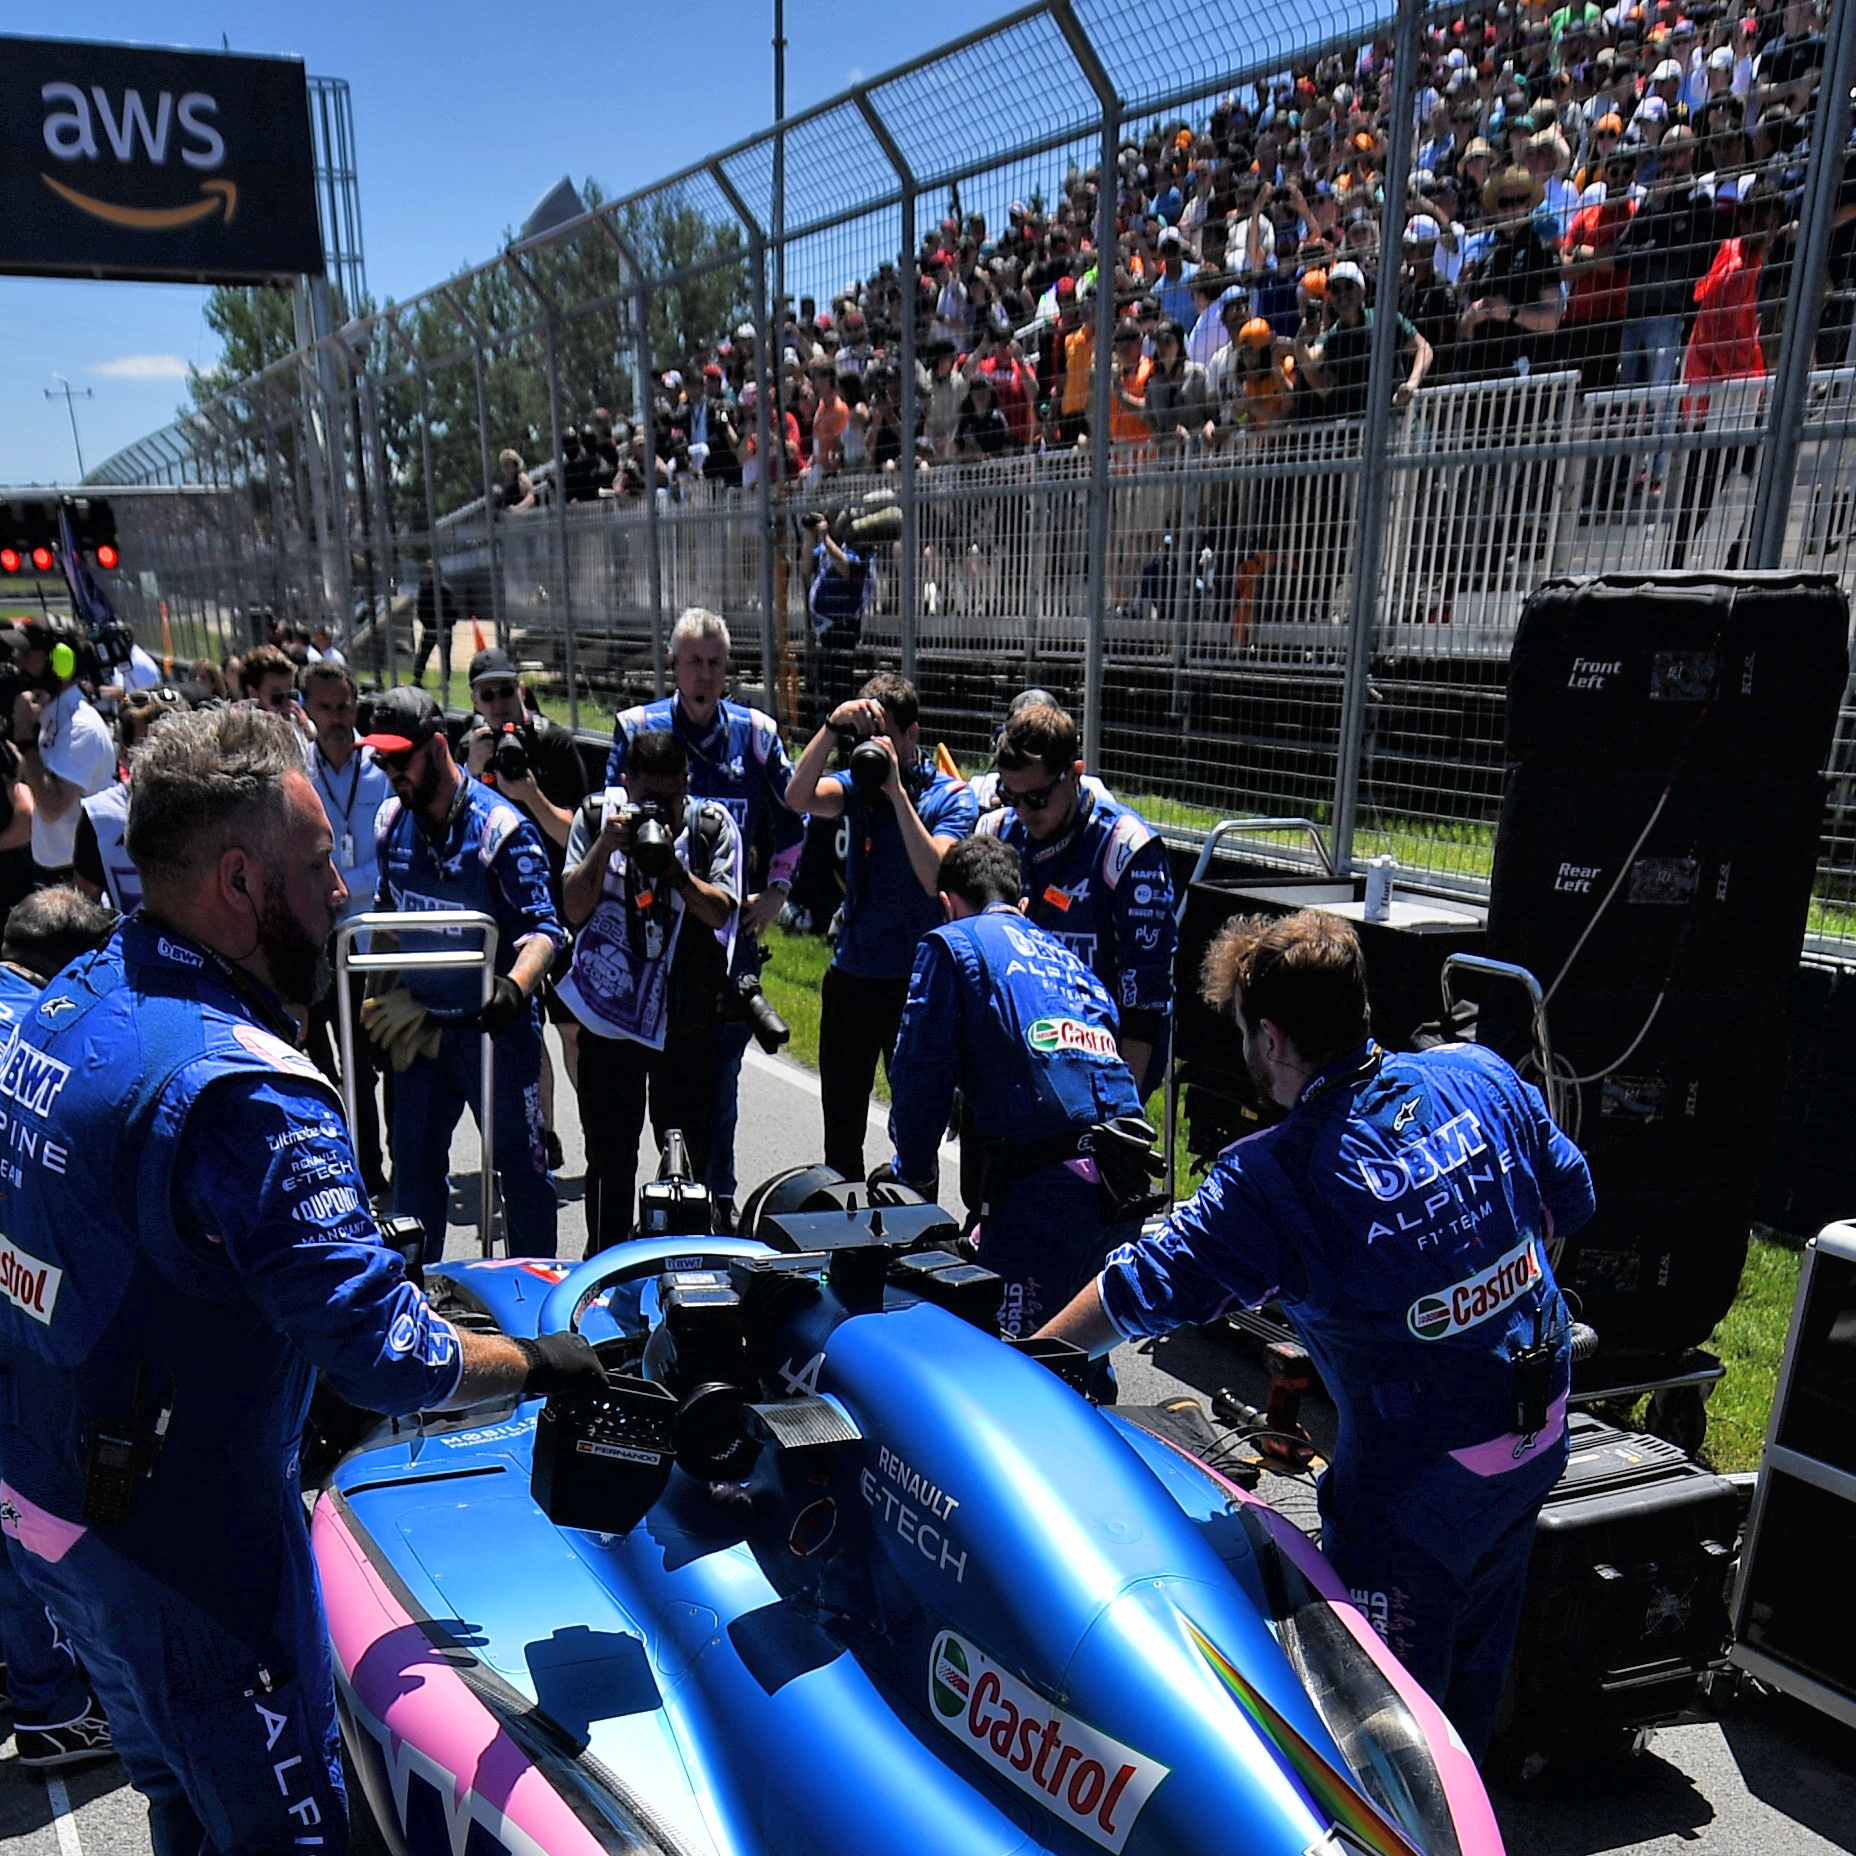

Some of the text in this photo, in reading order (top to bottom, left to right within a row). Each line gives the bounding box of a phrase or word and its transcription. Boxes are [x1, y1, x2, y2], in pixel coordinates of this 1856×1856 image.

[41, 81, 227, 170] aws
[1567, 674, 1605, 689] Left
[1572, 657, 1622, 675] Front
[1554, 877, 1591, 893] Left
[1558, 862, 1601, 879] Rear
[171, 945, 203, 968] BWT
[1061, 1022, 1116, 1053] Castro
[0, 1039, 72, 1119] BWT
[291, 1150, 338, 1173] RENAULT
[1401, 1110, 1488, 1190] BWT
[282, 1160, 354, 1192] E-TECH
[300, 1186, 360, 1223] DUPONT
[1367, 1150, 1516, 1245] ALPINE
[1448, 1200, 1493, 1235] TEAM
[1451, 1241, 1539, 1329] Castrol
[1007, 1282, 1024, 1335] ORLD
[441, 1416, 538, 1446] MOBILIZ
[595, 1446, 658, 1464] FERNANDO
[878, 1445, 960, 1522] RENAULT
[860, 1467, 969, 1584] E-TECH
[968, 1670, 1137, 1836] Castrol
